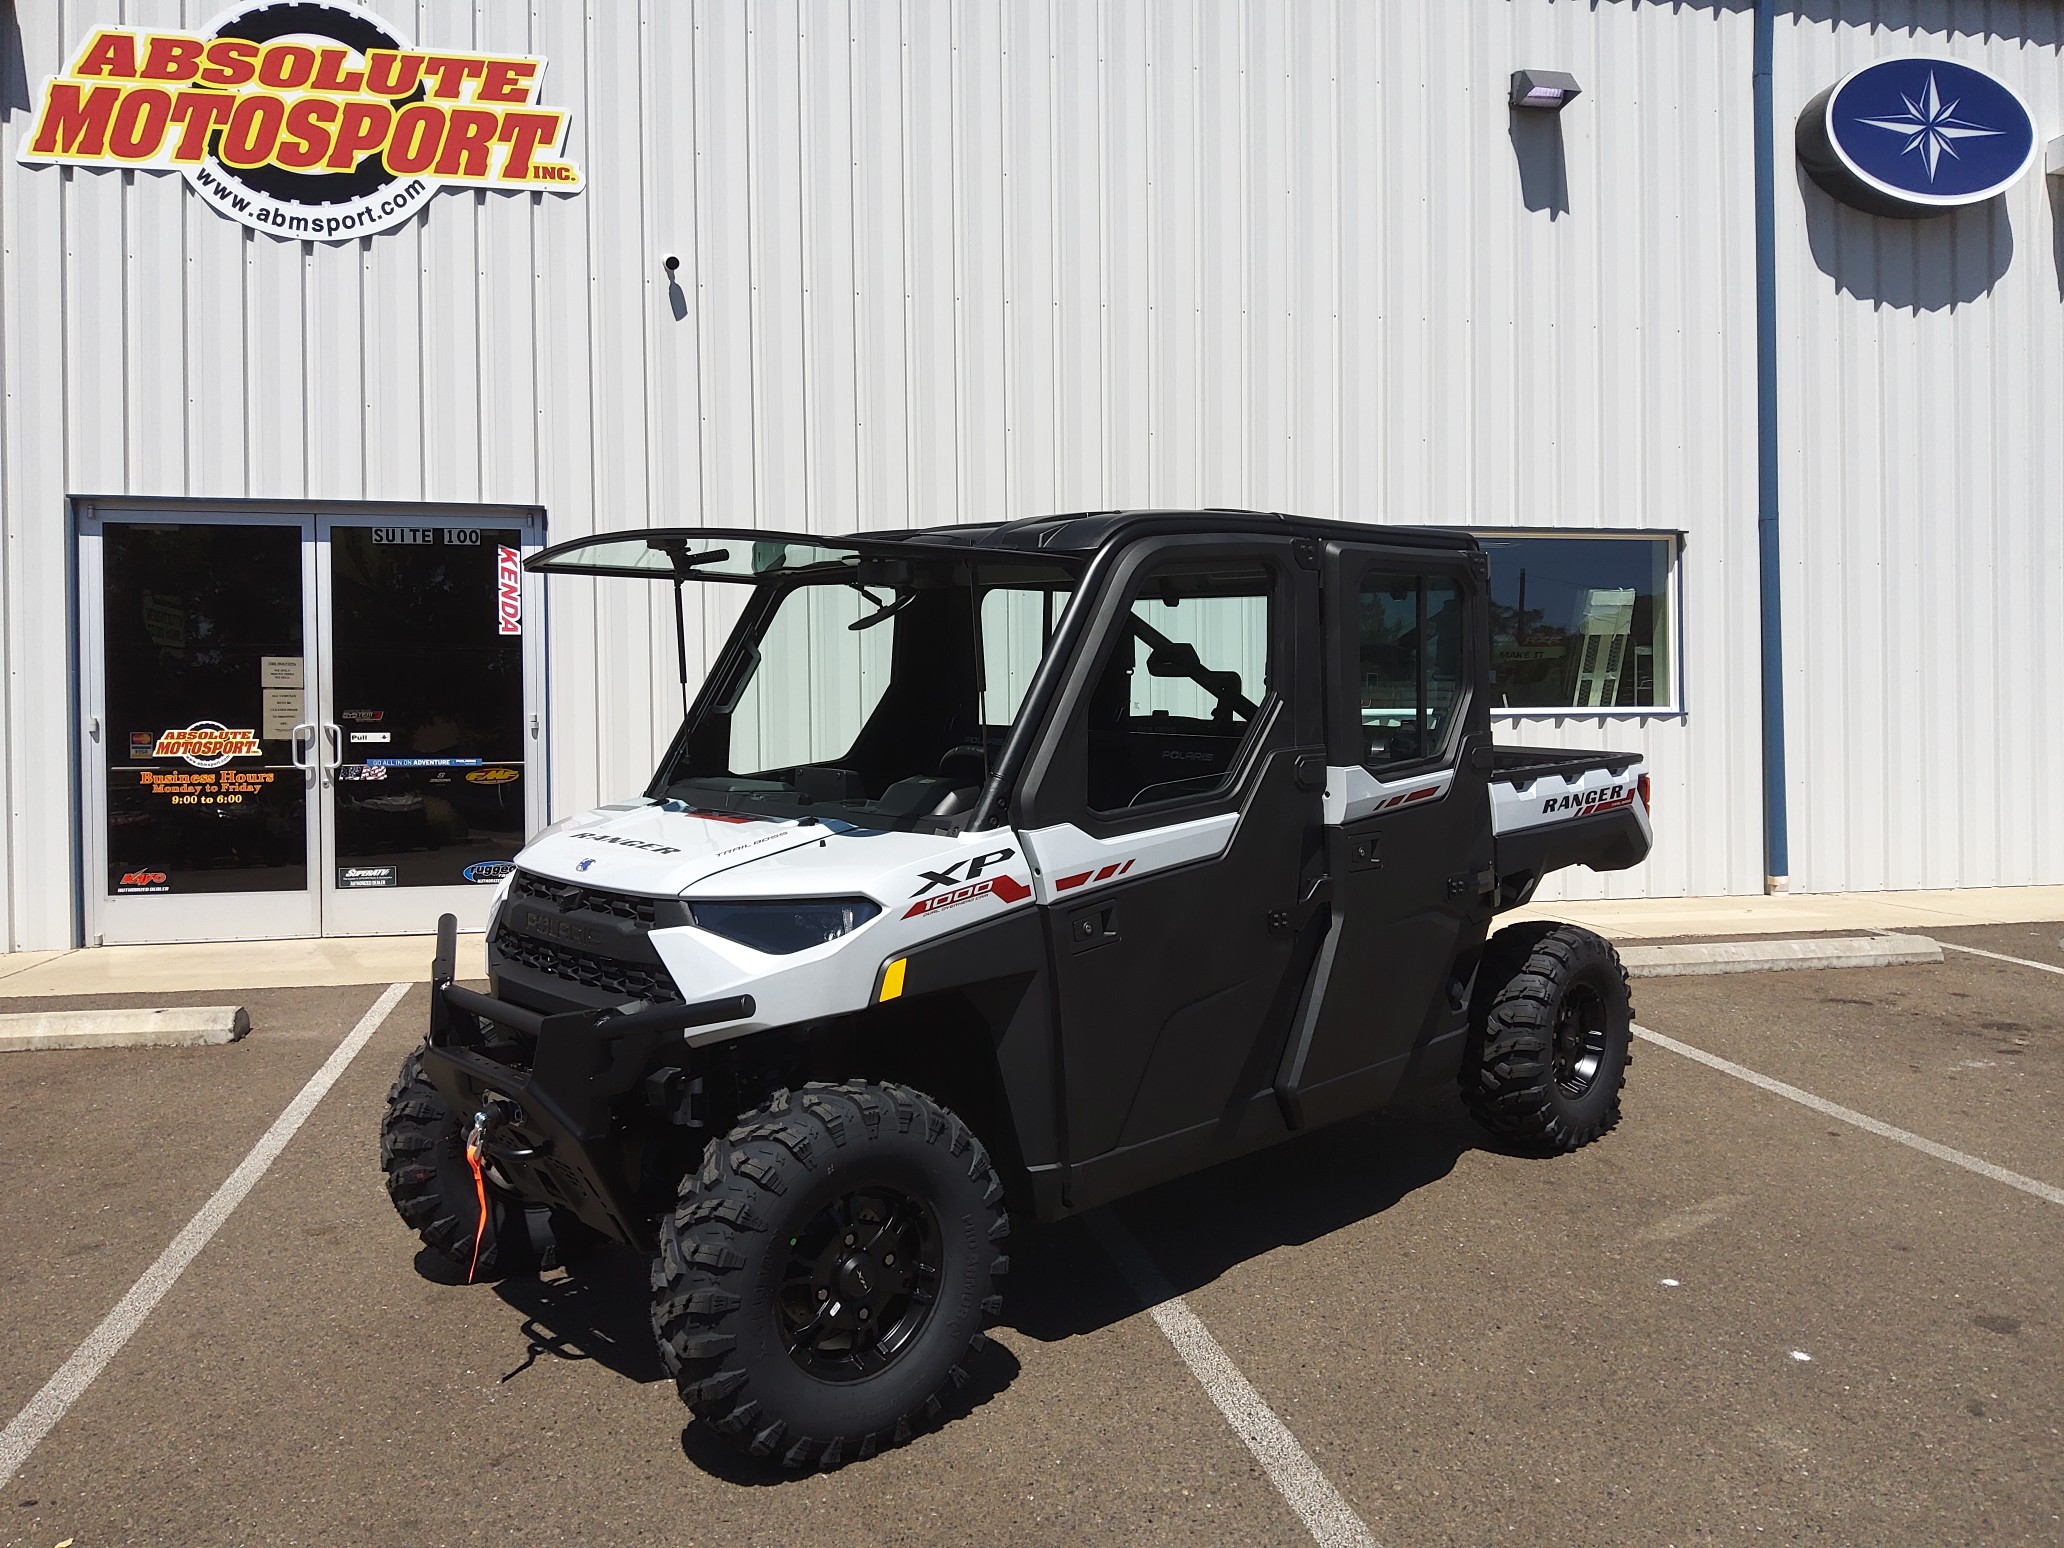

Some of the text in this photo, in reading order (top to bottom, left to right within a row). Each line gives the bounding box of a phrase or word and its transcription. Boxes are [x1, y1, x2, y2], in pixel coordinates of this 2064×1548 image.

[76, 32, 542, 103] ABSOLUTE
[32, 84, 577, 183] MOTOSPORT INC.
[196, 166, 427, 237] www.abmsport.com
[373, 528, 480, 544] SUITE 100
[499, 545, 520, 633] KENDA
[164, 731, 252, 740] ABSOLUTE
[155, 740, 257, 755] MOTOSPORT
[1161, 750, 1214, 762] POLARIS
[139, 770, 275, 784] Business Hours
[152, 782, 262, 795] Monday to Friday
[171, 794, 243, 805] 9:00 to 6:00
[1542, 784, 1624, 814] RANGER
[569, 832, 682, 855] RANGER
[715, 831, 789, 858] TRAIL BOSS
[908, 847, 1016, 899] XP
[924, 880, 994, 911] 1000
[922, 908, 940, 918] DUAL
